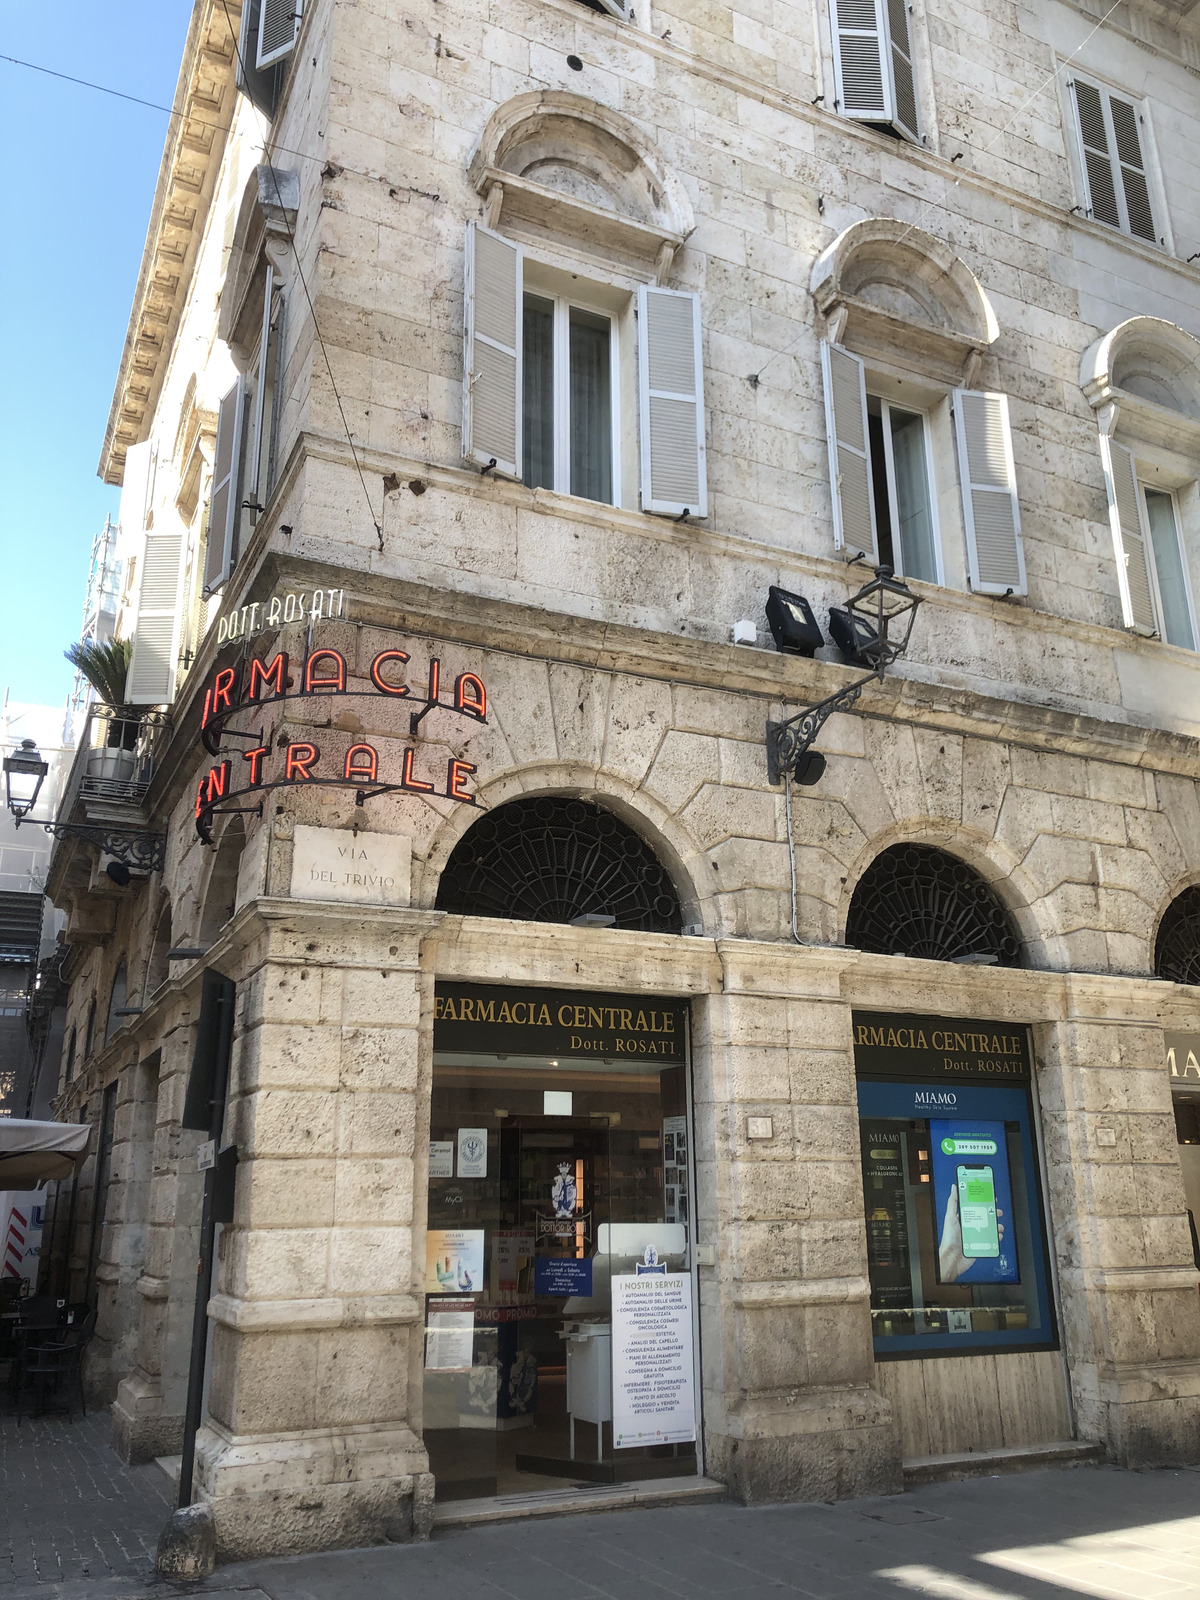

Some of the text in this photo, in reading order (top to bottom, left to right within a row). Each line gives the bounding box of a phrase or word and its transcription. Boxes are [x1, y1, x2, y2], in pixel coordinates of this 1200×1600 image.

[217, 588, 344, 644] DOTT. ROSATI
[202, 649, 488, 729] RMACIA
[337, 846, 368, 860] VIA
[311, 870, 395, 888] DEL TRIVIO
[433, 996, 675, 1033] FARMACIA CENTRALE
[570, 1035, 676, 1055] Dott. ROSATI
[931, 1030, 1022, 1055] CENTRALE
[943, 1058, 1023, 1073] Dott. ROSATI
[914, 1091, 957, 1104] MIAMO
[625, 1281, 653, 1290] NOSTRI
[655, 1280, 683, 1288] SERVIZI
